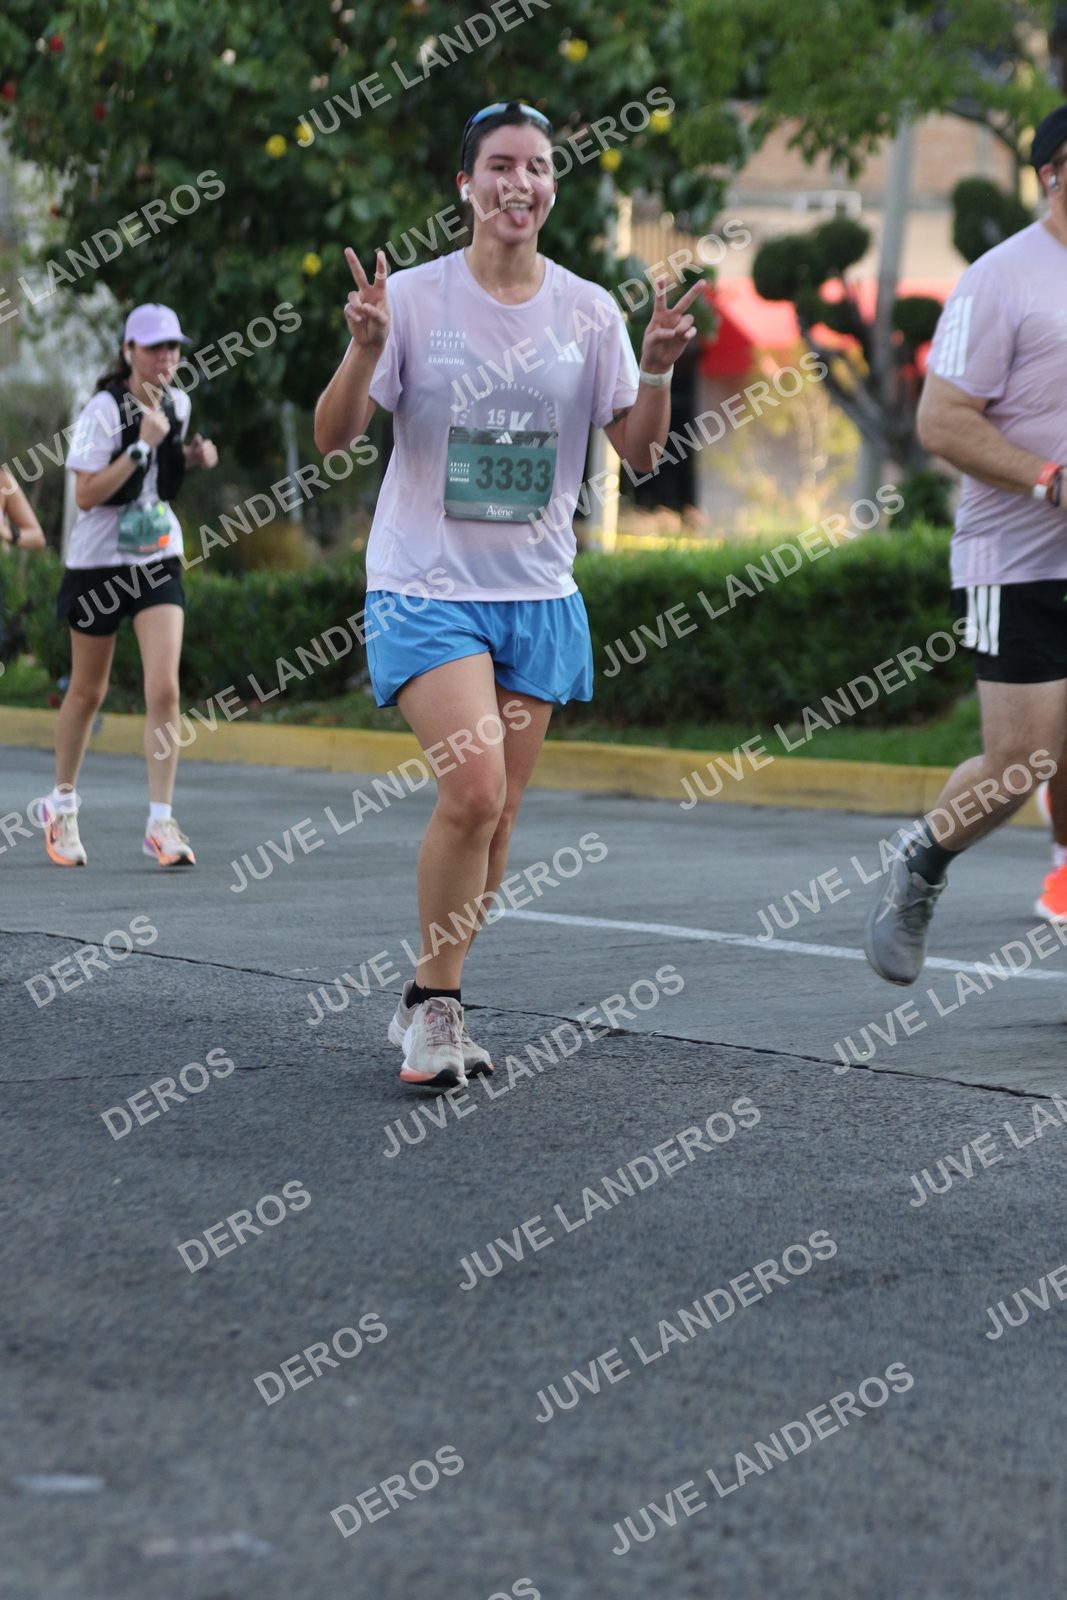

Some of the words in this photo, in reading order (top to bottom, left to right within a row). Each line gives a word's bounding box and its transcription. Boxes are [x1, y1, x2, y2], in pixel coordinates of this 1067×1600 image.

[428, 357, 465, 366] SAMSUNG
[487, 408, 505, 426] 15
[509, 410, 533, 430] K
[475, 455, 550, 492] 3333
